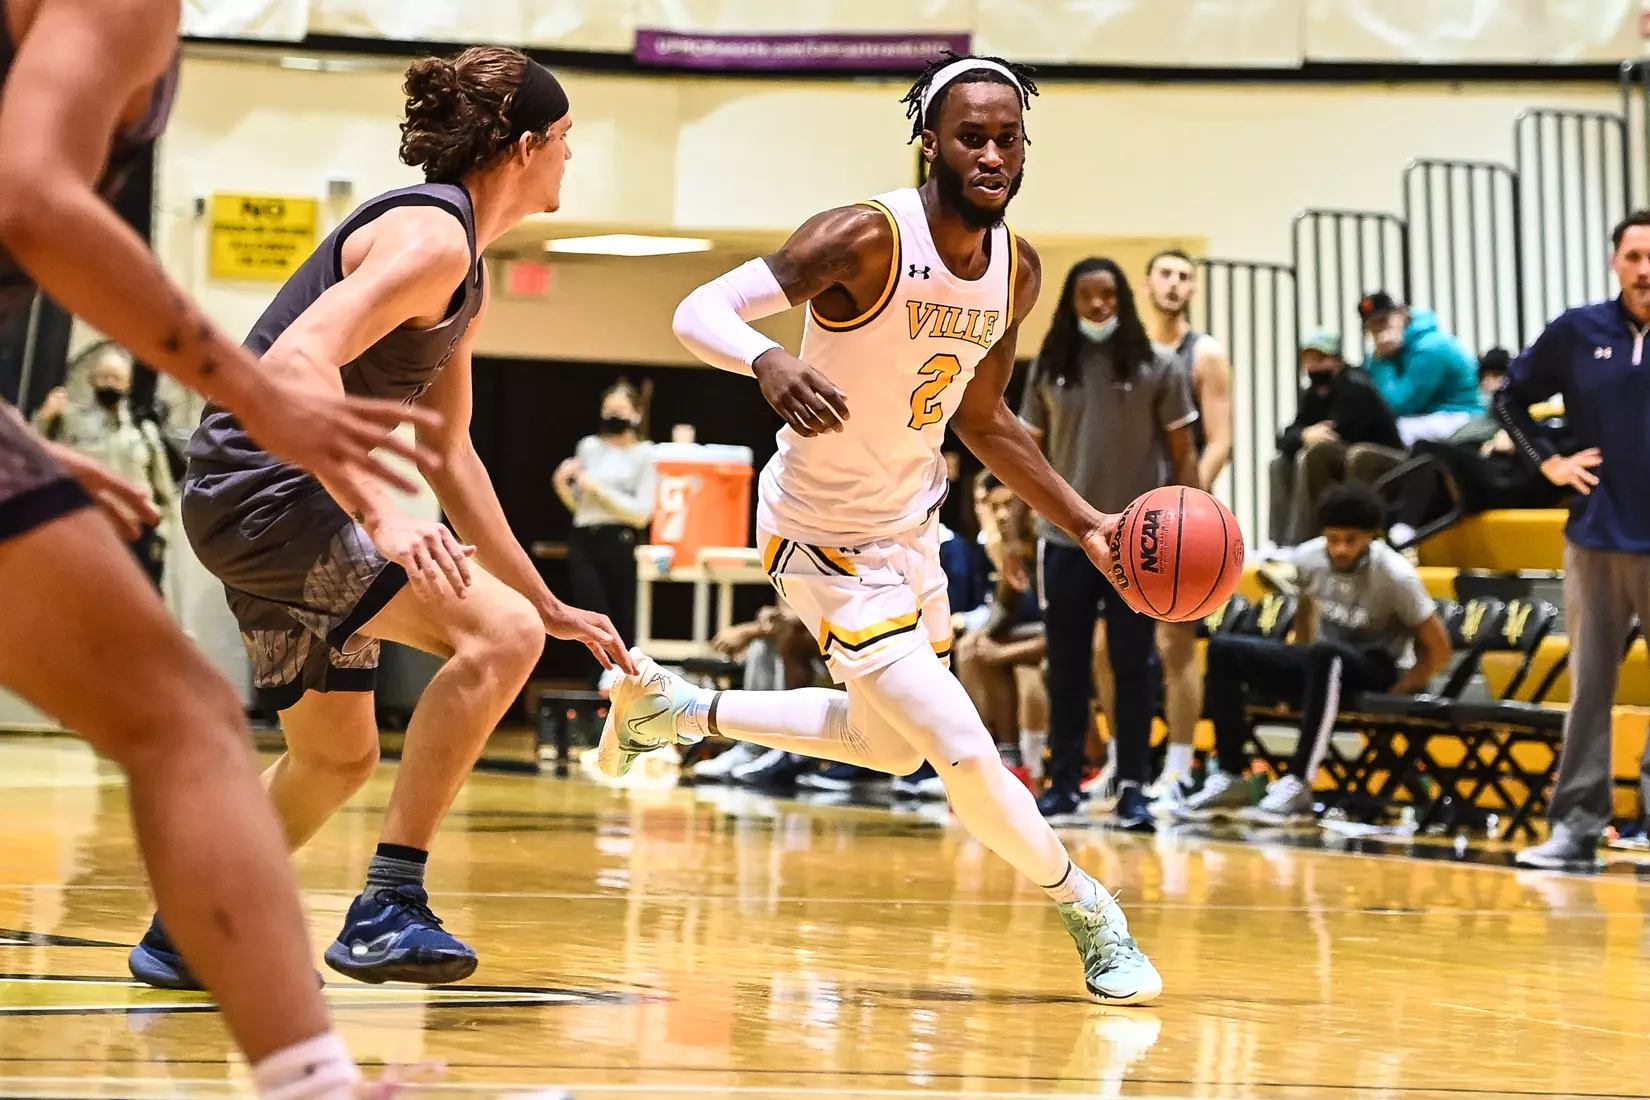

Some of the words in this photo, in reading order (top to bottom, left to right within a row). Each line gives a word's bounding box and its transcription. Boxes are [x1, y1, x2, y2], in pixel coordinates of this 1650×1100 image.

[241, 198, 286, 216] NO
[905, 299, 1000, 349] VILLE
[907, 353, 962, 431] 2
[1140, 509, 1164, 574] NCAA
